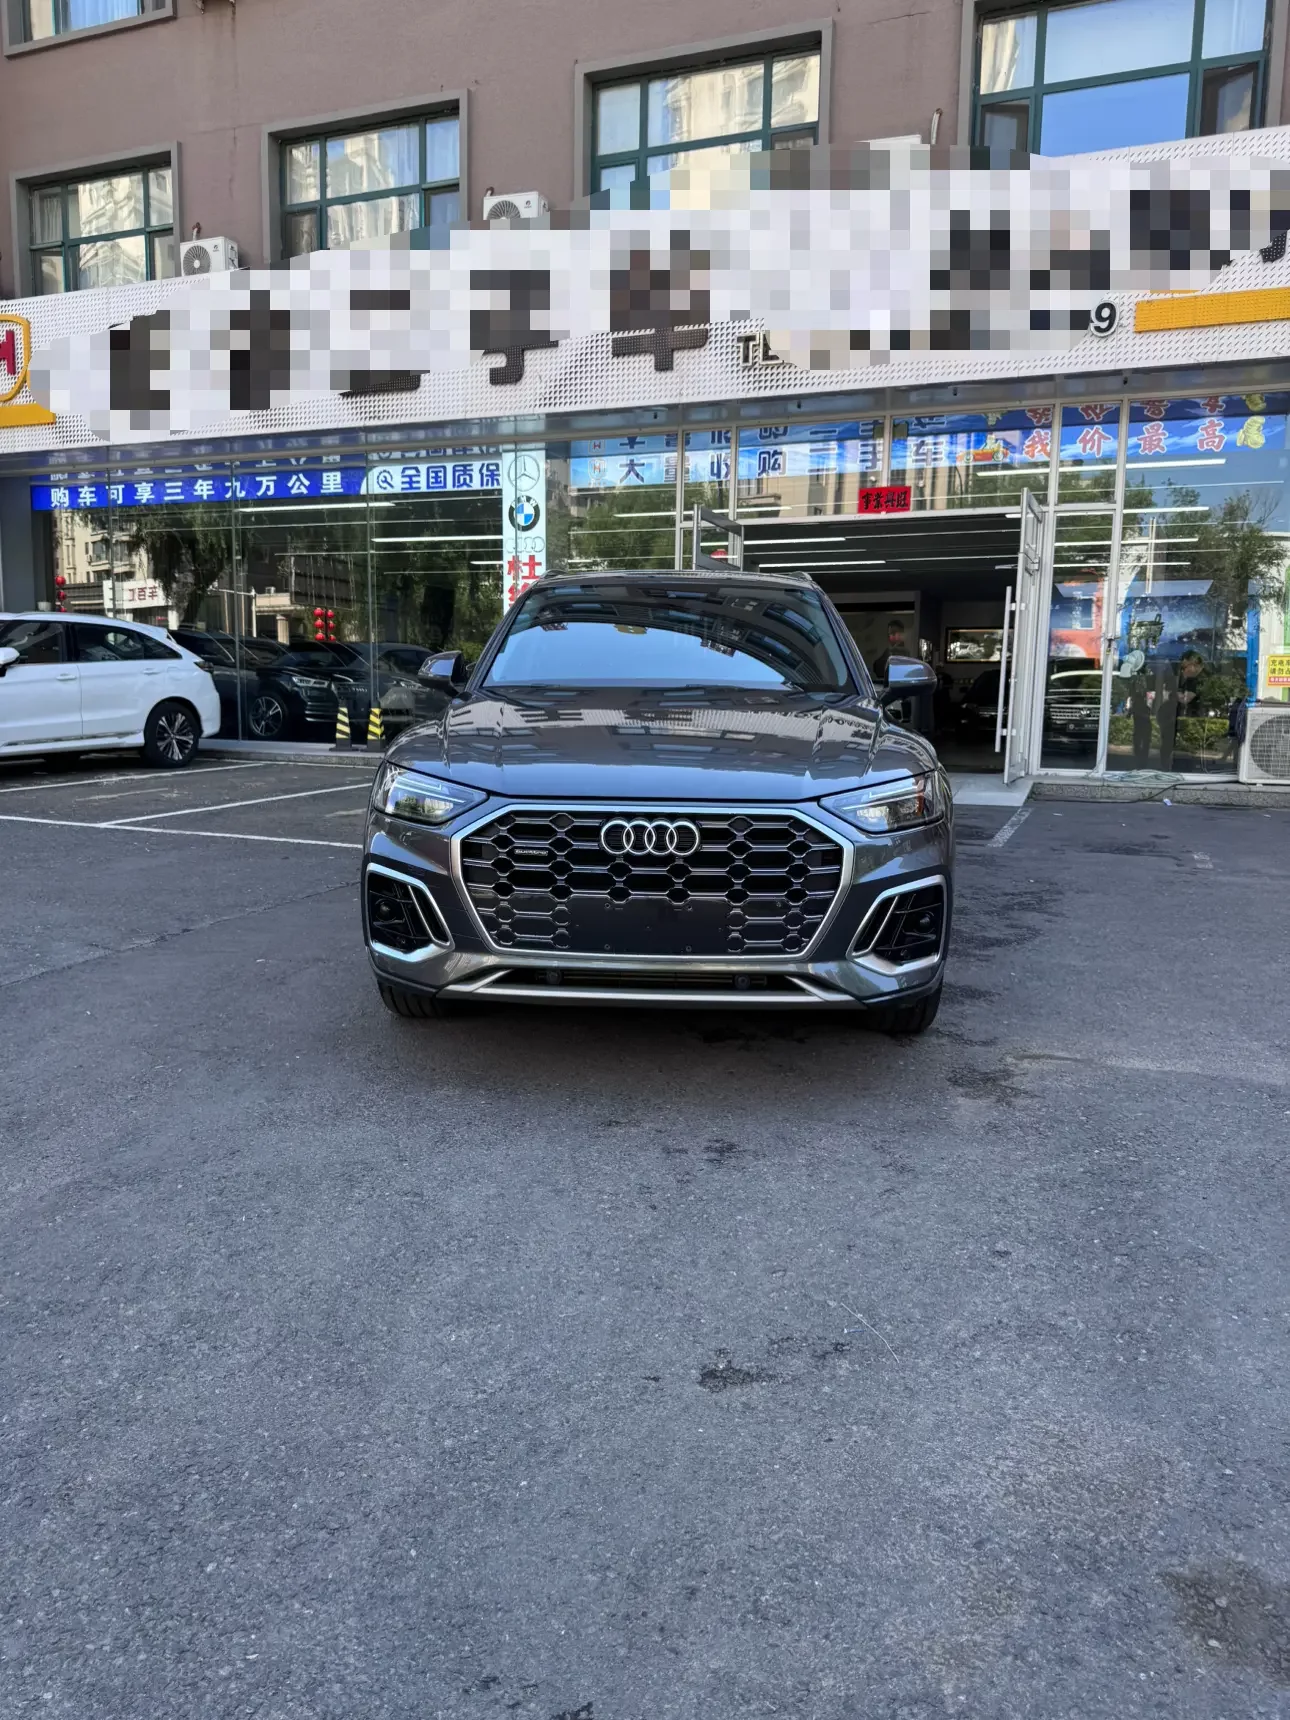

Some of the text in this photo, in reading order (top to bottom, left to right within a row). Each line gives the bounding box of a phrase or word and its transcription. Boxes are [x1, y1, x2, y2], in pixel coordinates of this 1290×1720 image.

[51, 462, 501, 508] 购车可享三年九万公里 全国质保
